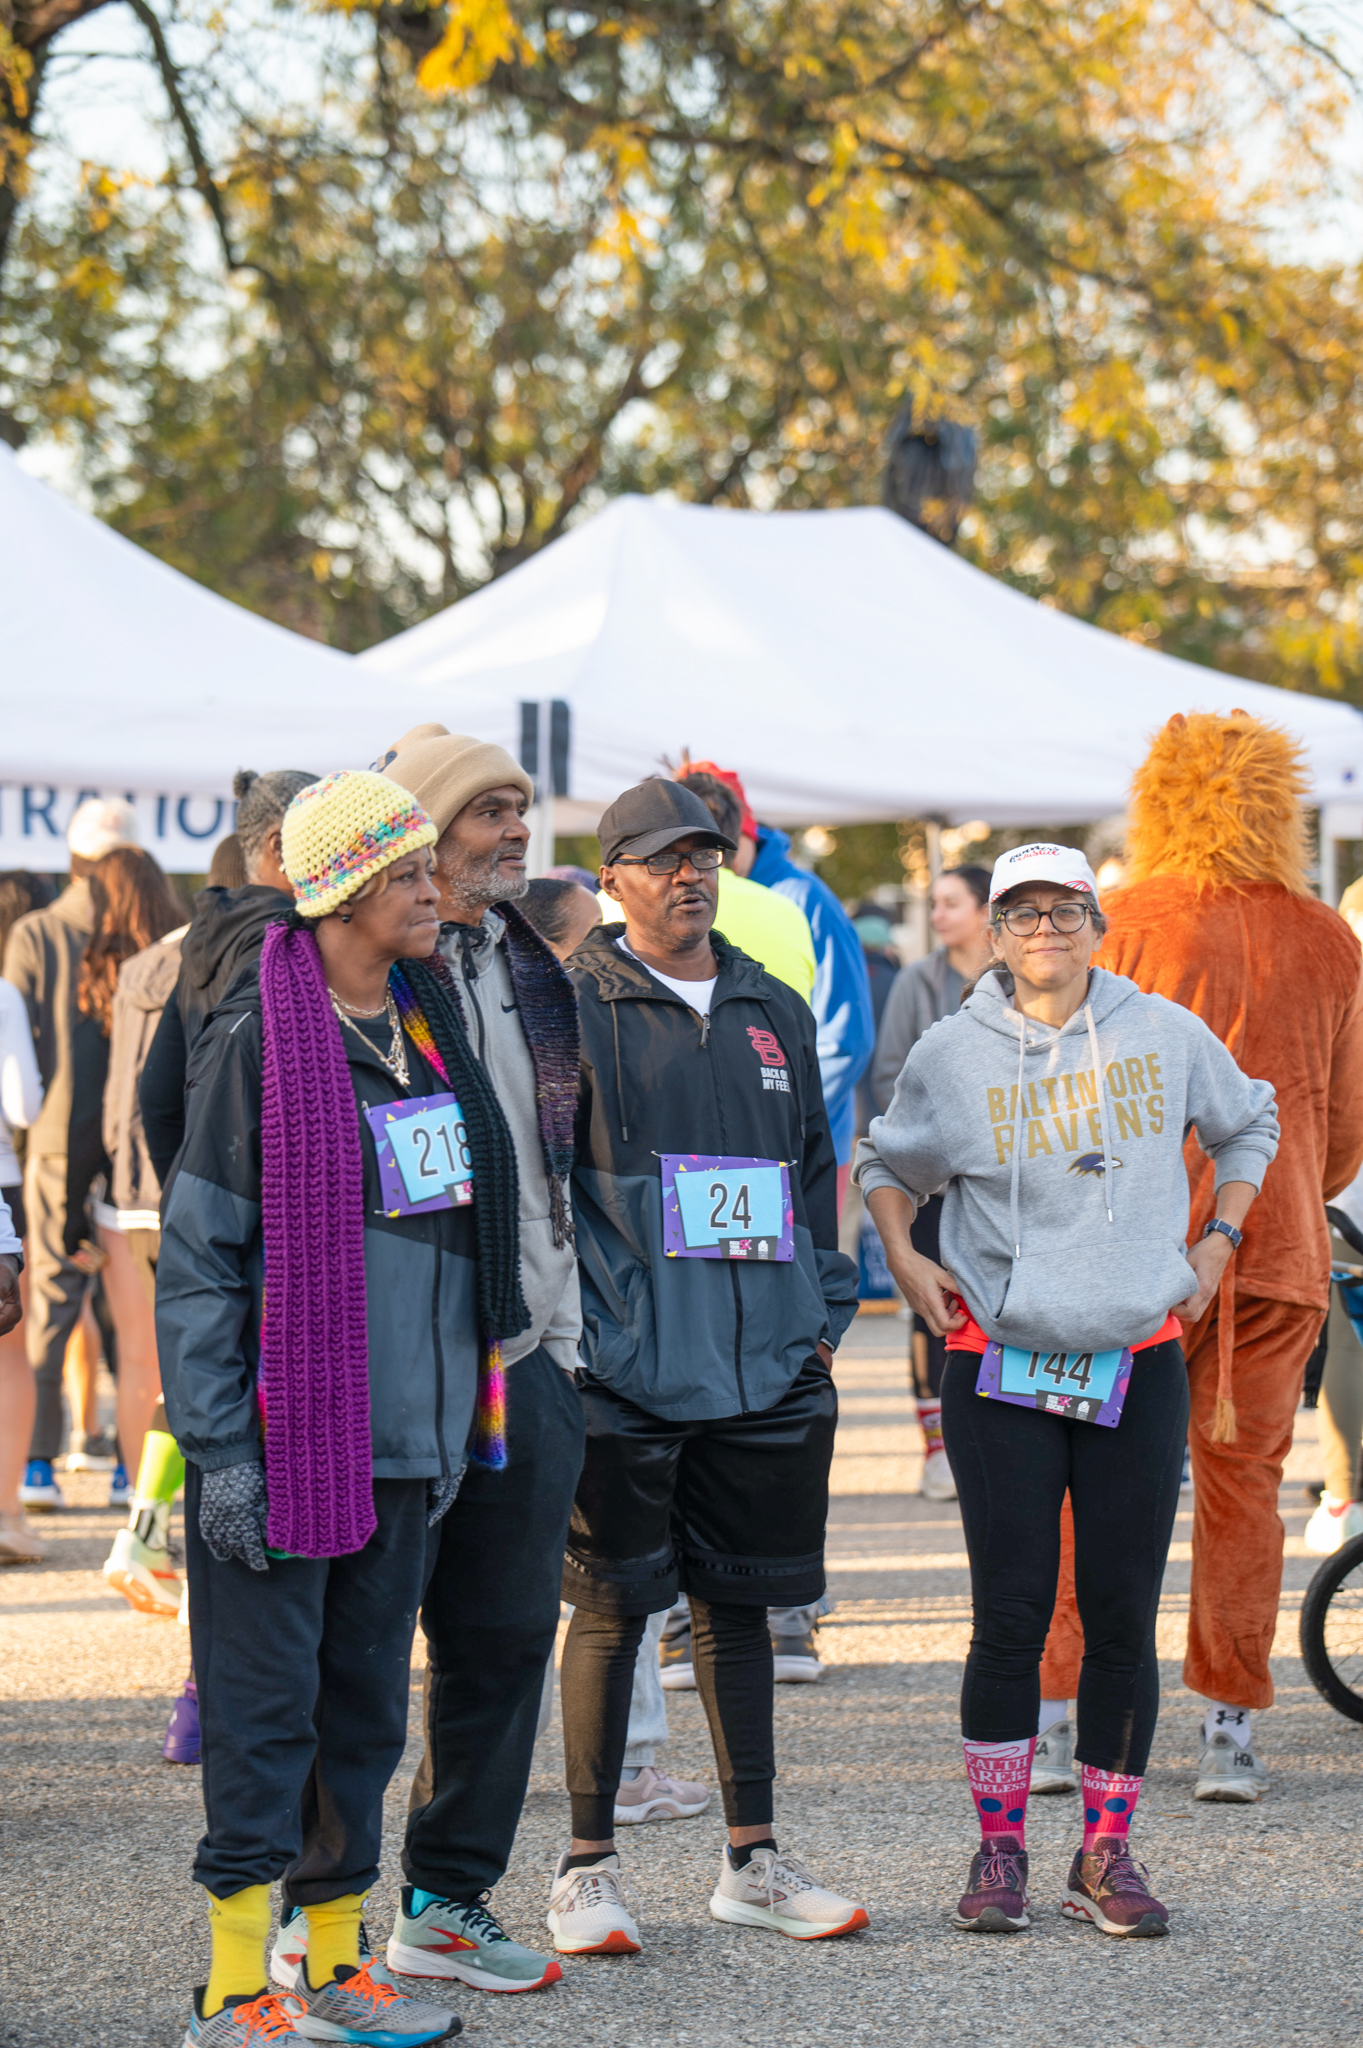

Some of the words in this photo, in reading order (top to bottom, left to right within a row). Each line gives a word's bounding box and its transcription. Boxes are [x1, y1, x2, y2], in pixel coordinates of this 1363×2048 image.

[775, 1080, 791, 1093] FEE
[412, 1121, 473, 1178] 218
[709, 1183, 752, 1230] 24
[966, 1754, 1029, 1772] EALTH
[969, 1767, 1011, 1784] ARE
[1083, 1777, 1142, 1793] HOMELE
